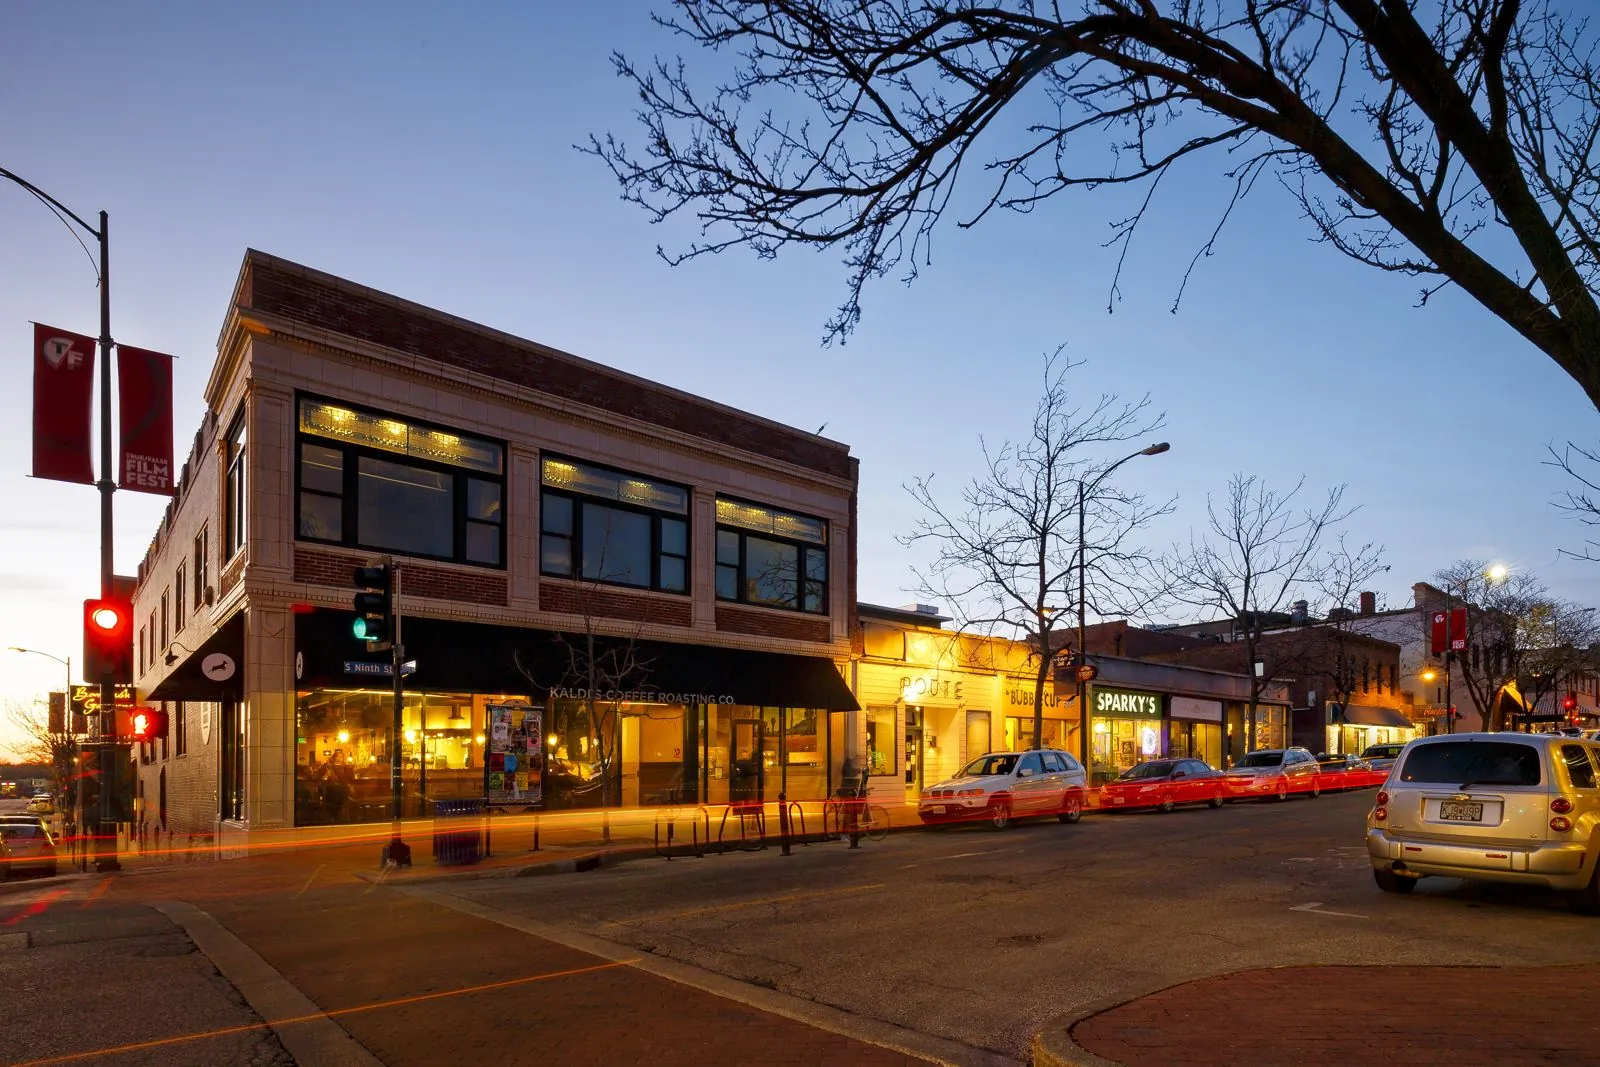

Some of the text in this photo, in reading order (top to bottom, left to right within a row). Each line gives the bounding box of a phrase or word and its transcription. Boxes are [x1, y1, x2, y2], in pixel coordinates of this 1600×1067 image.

[126, 458, 168, 477] FILM
[126, 472, 169, 488] FEST
[345, 663, 351, 671] S
[354, 663, 380, 673] Ninth
[384, 664, 393, 673] St
[549, 686, 736, 706] KALDIS COFFEE ROASTING CO.
[1010, 689, 1043, 706] BUBB
[1097, 692, 1156, 714] SPARKY'S
